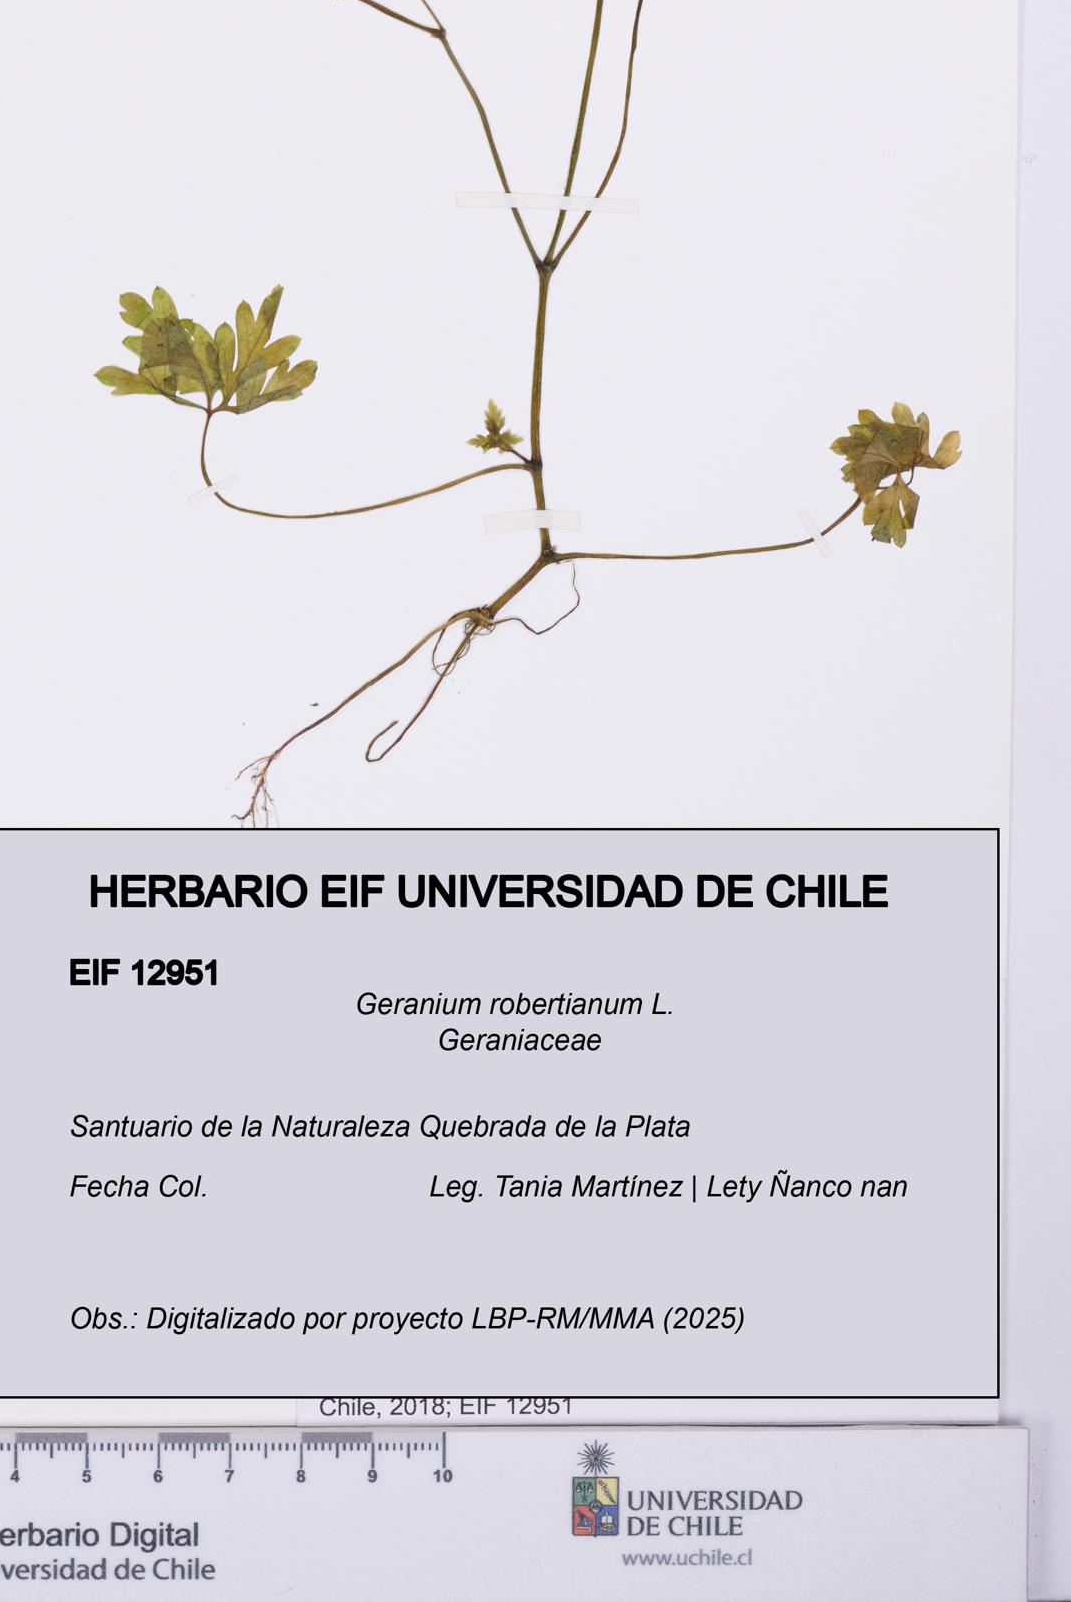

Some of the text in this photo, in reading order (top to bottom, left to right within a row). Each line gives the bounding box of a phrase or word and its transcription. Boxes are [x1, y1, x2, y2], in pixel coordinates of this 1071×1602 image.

[319, 1400, 571, 1420] Chile, 2018; EIF 12951
[9, 1469, 21, 1484] 4
[81, 1469, 93, 1484] 5
[152, 1469, 164, 1484] 6
[224, 1469, 235, 1483] 7
[295, 1468, 307, 1484] 8
[367, 1468, 378, 1484] 9
[432, 1468, 454, 1484] 10
[627, 1489, 803, 1512] UNIVERSIDAD
[110, 1521, 199, 1551] Digital
[626, 1515, 743, 1537] DE CHILE
[622, 1548, 752, 1566] www.uchile.cl
[113, 1557, 146, 1581] de
[152, 1557, 216, 1581] Chile
